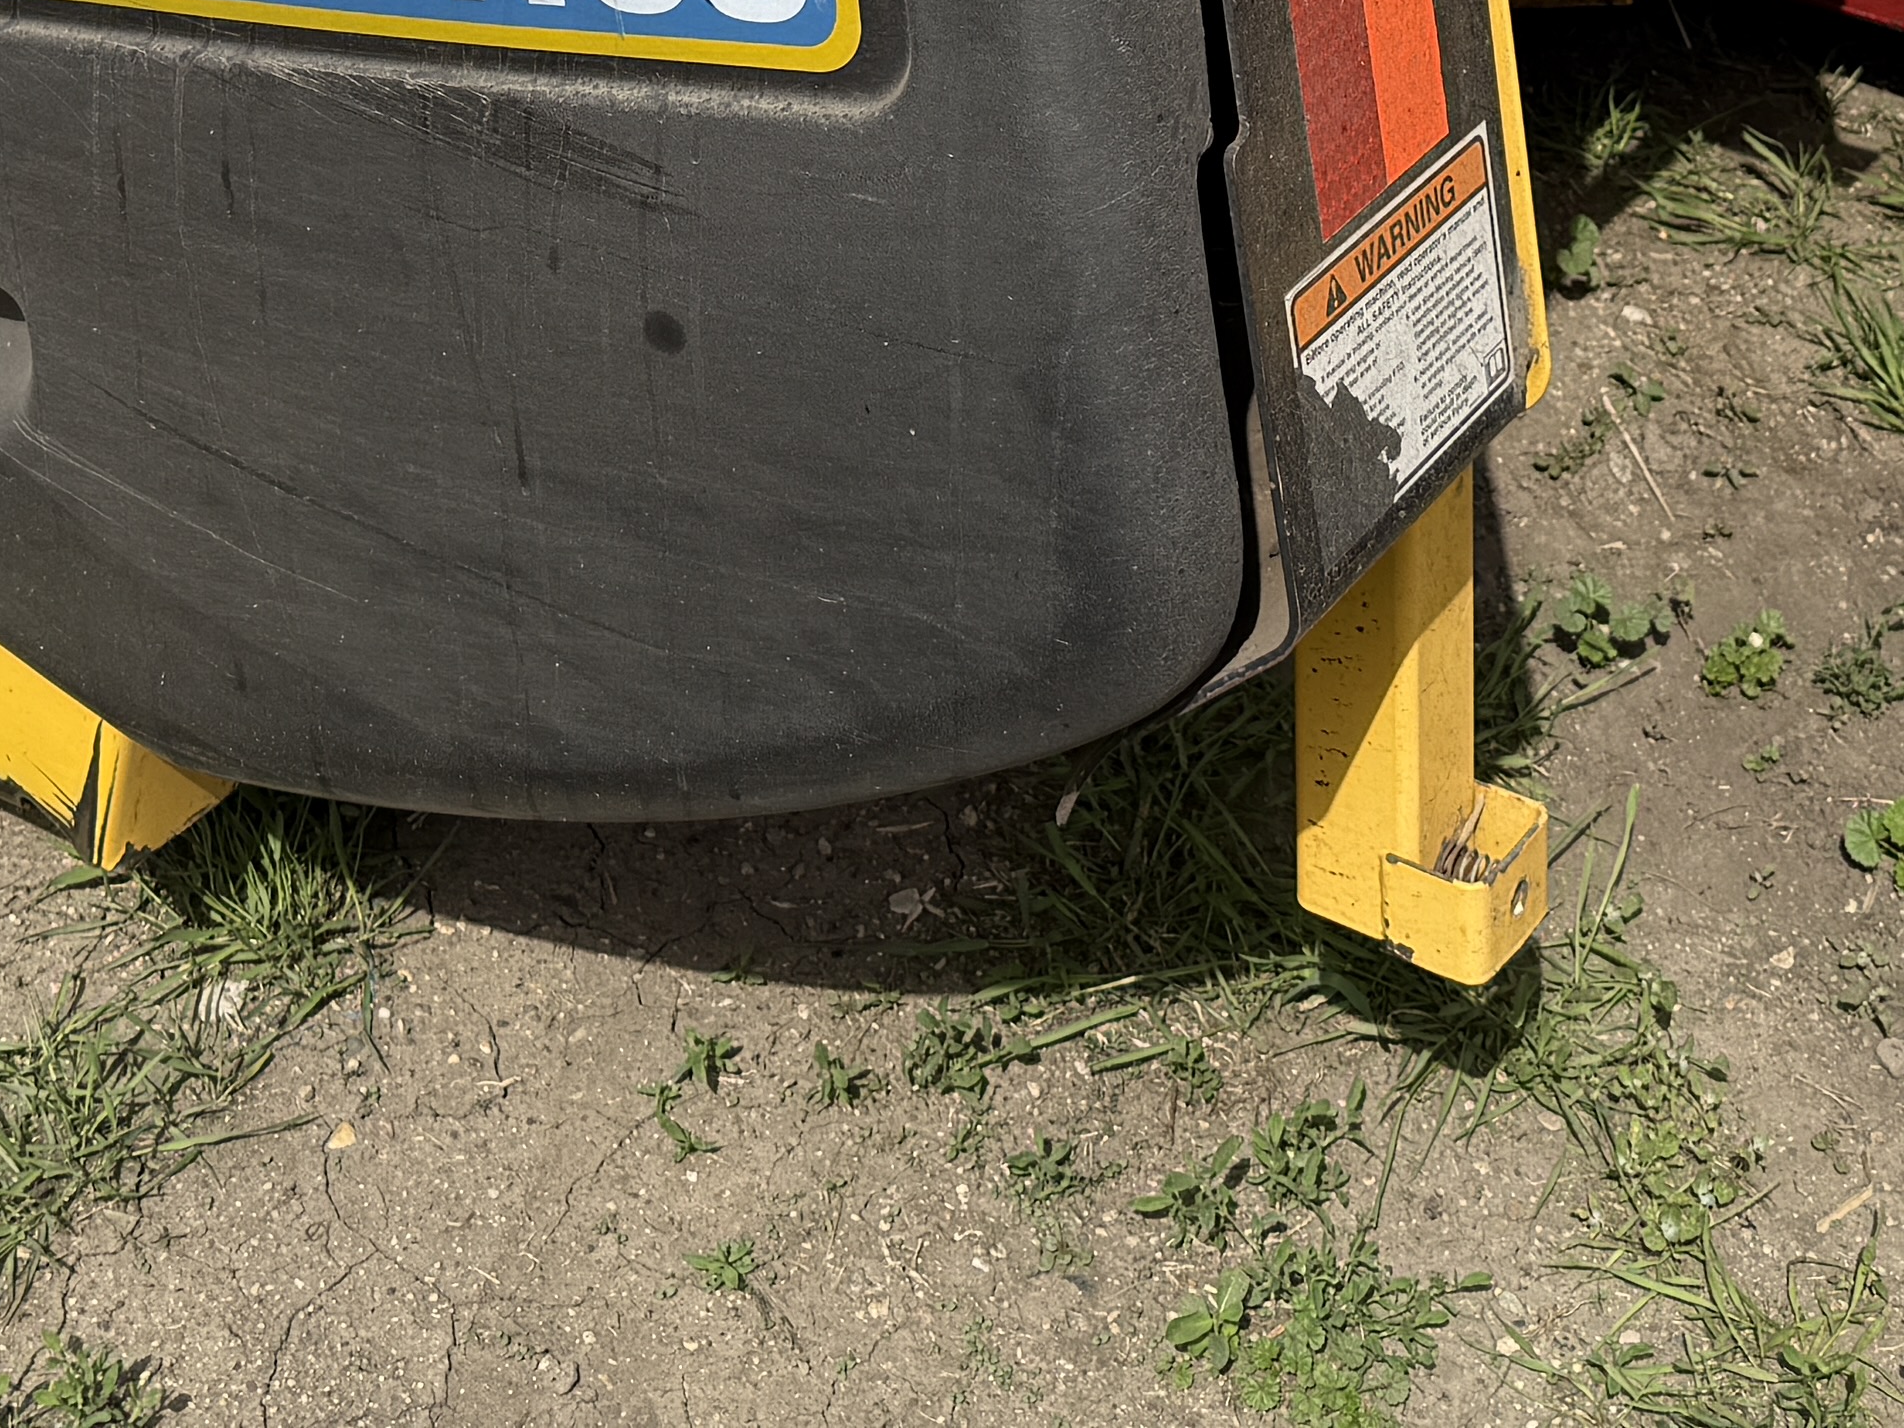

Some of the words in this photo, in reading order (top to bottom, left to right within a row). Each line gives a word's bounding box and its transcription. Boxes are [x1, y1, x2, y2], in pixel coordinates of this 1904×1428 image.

[1354, 173, 1457, 282] WARNING
[1356, 315, 1371, 337] ALL
[1371, 288, 1399, 322] SAFETY
